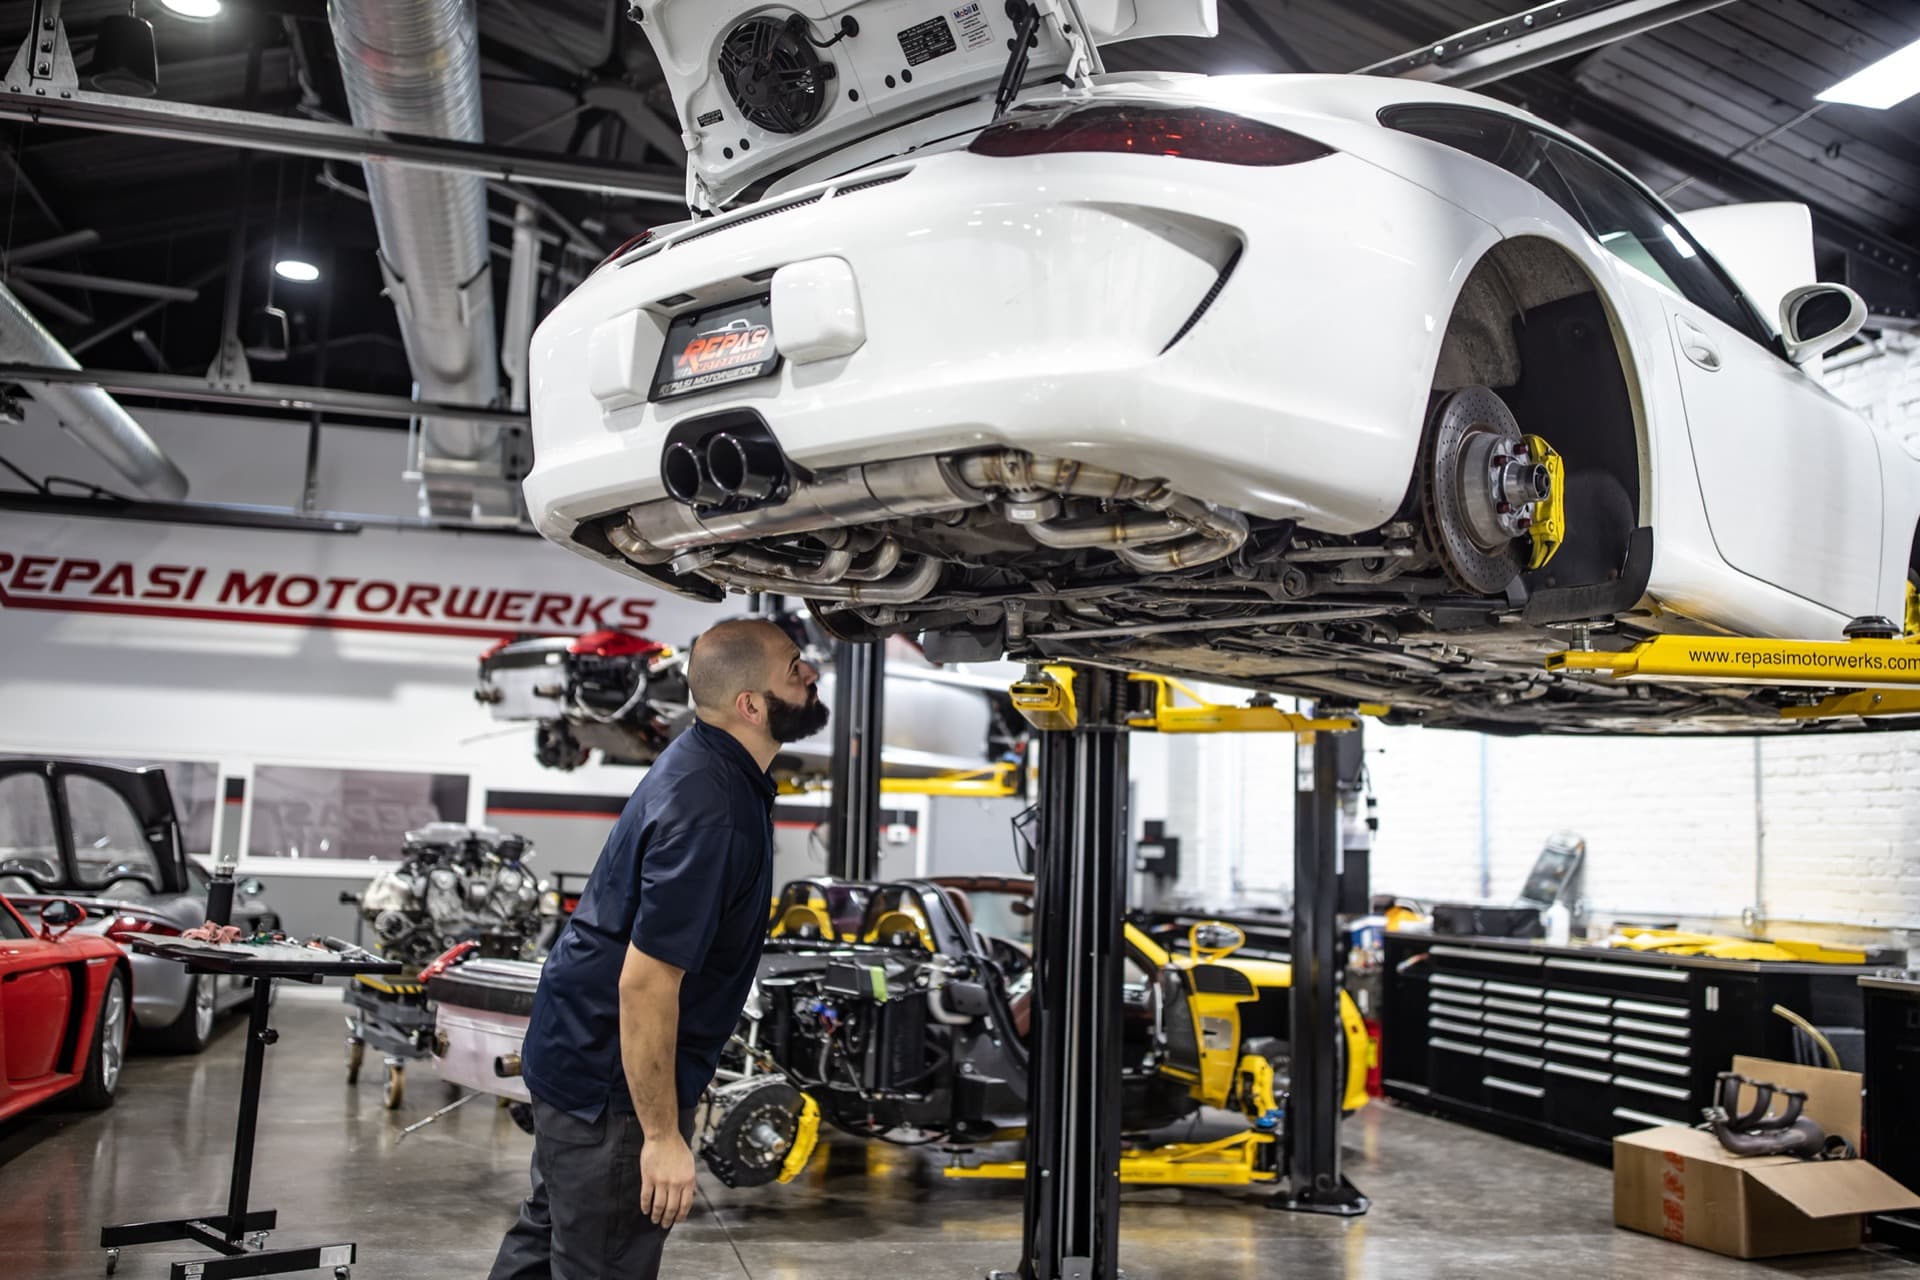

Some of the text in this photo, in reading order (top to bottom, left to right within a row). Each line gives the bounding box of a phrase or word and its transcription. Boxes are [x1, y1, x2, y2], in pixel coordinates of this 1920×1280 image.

[953, 6, 972, 18] Mobil
[216, 569, 656, 630] MOTORWERKS
[1689, 650, 1920, 671] www.repasimotorwerks.com
